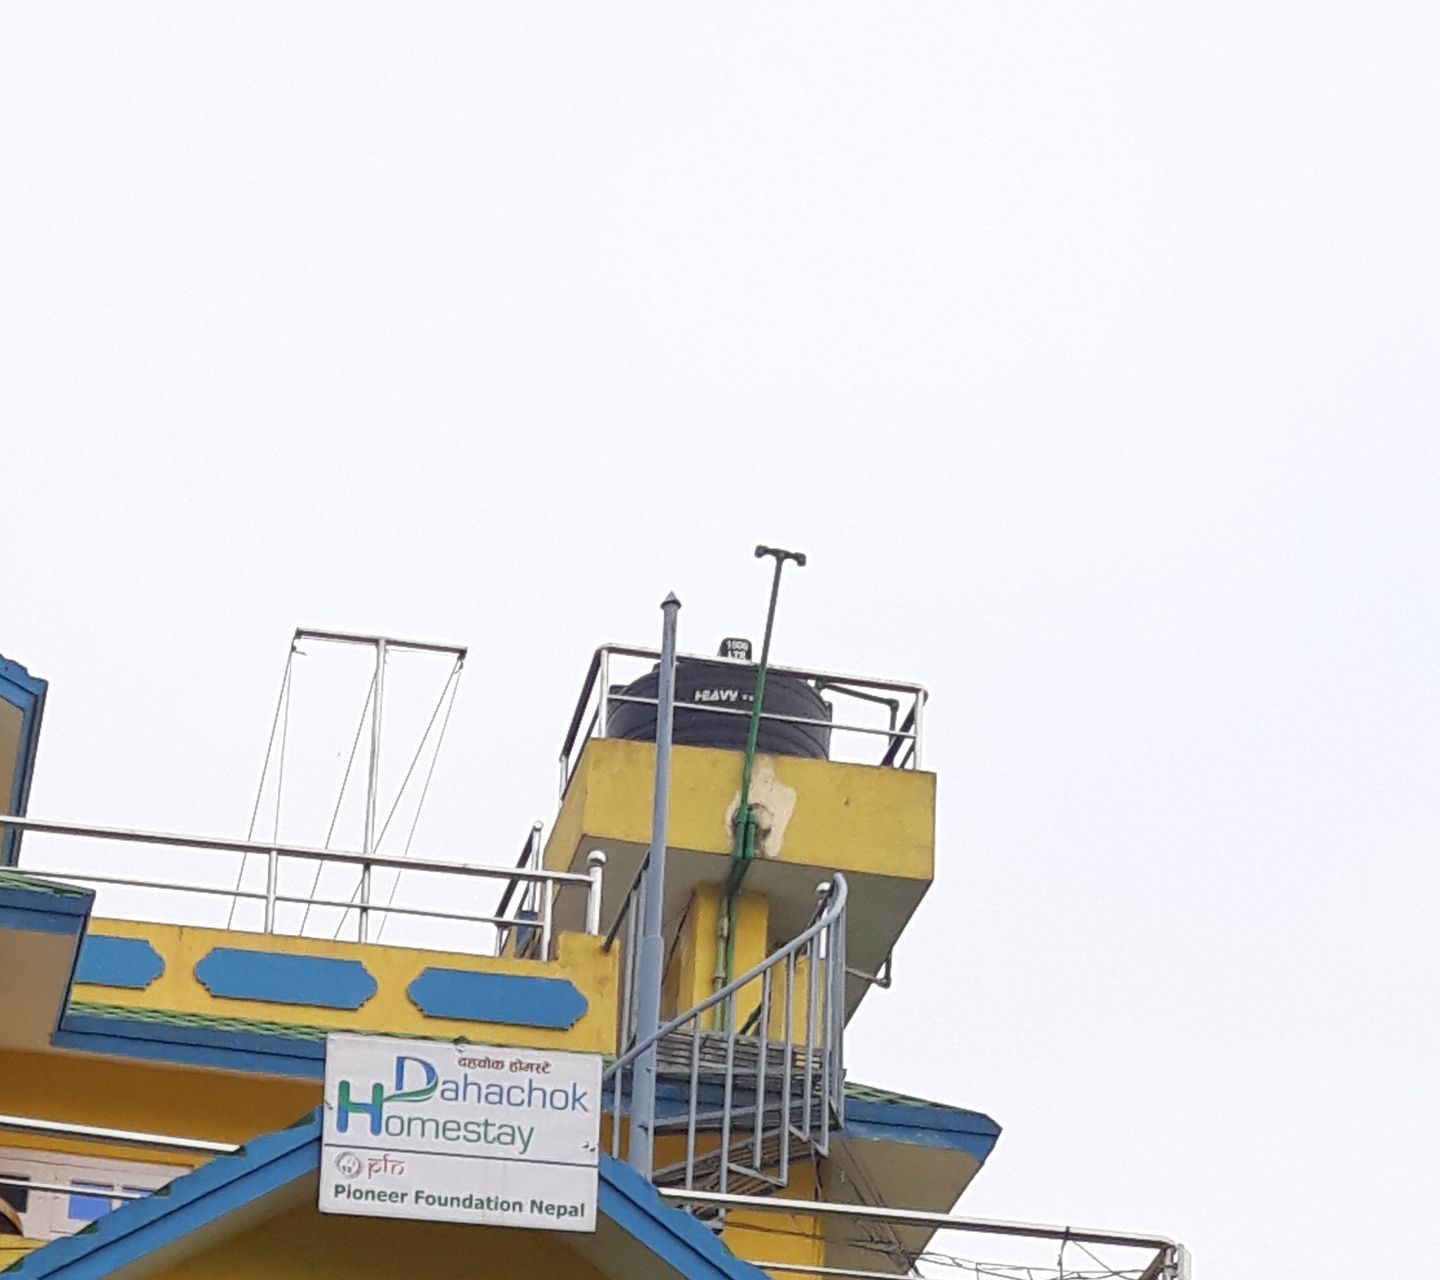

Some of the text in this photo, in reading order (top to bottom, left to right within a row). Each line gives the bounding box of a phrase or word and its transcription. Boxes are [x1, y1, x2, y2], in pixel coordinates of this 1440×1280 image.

[394, 1056, 589, 1112] Dahachok
[336, 1080, 535, 1155] Homestay
[334, 1184, 585, 1219] Pioneer Foundation Nepal
